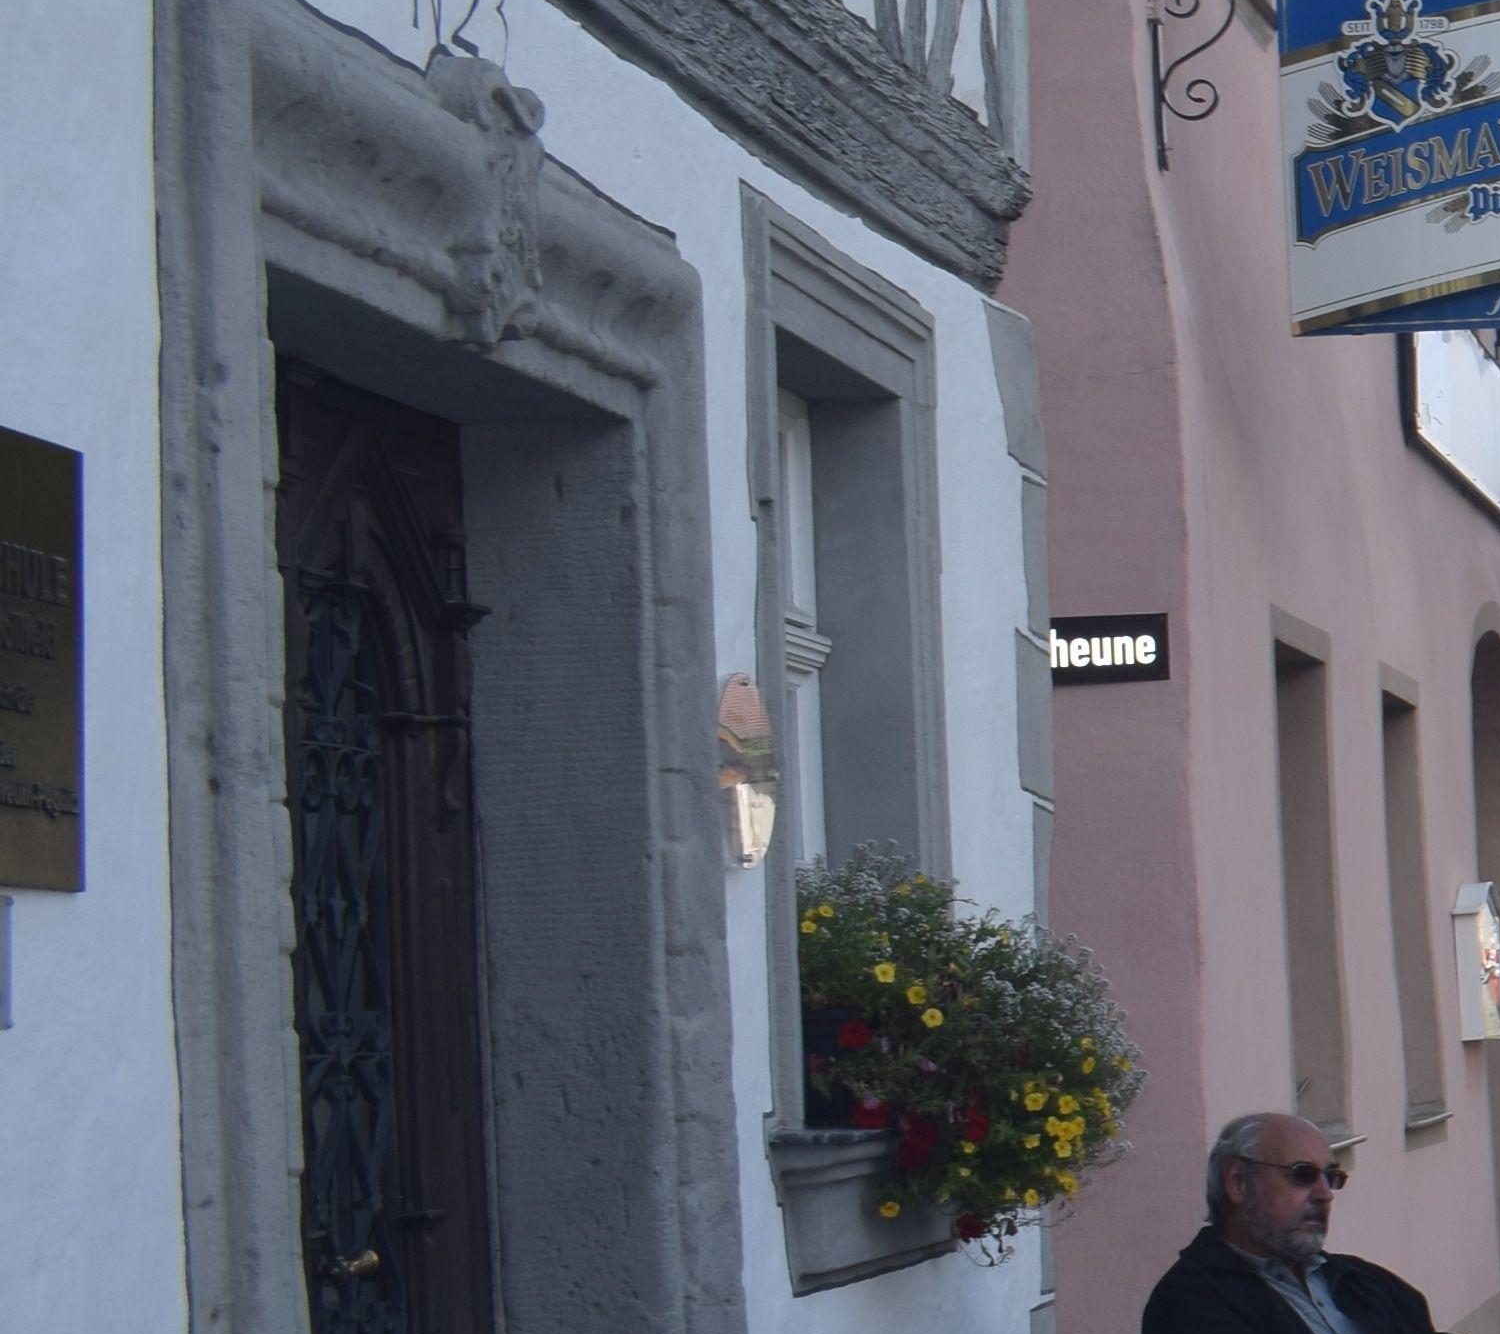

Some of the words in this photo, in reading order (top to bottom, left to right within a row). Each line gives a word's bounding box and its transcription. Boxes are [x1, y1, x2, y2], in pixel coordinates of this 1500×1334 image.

[1346, 22, 1371, 33] SEIT
[1419, 18, 1445, 30] 1798
[1049, 628, 1156, 668] heune
